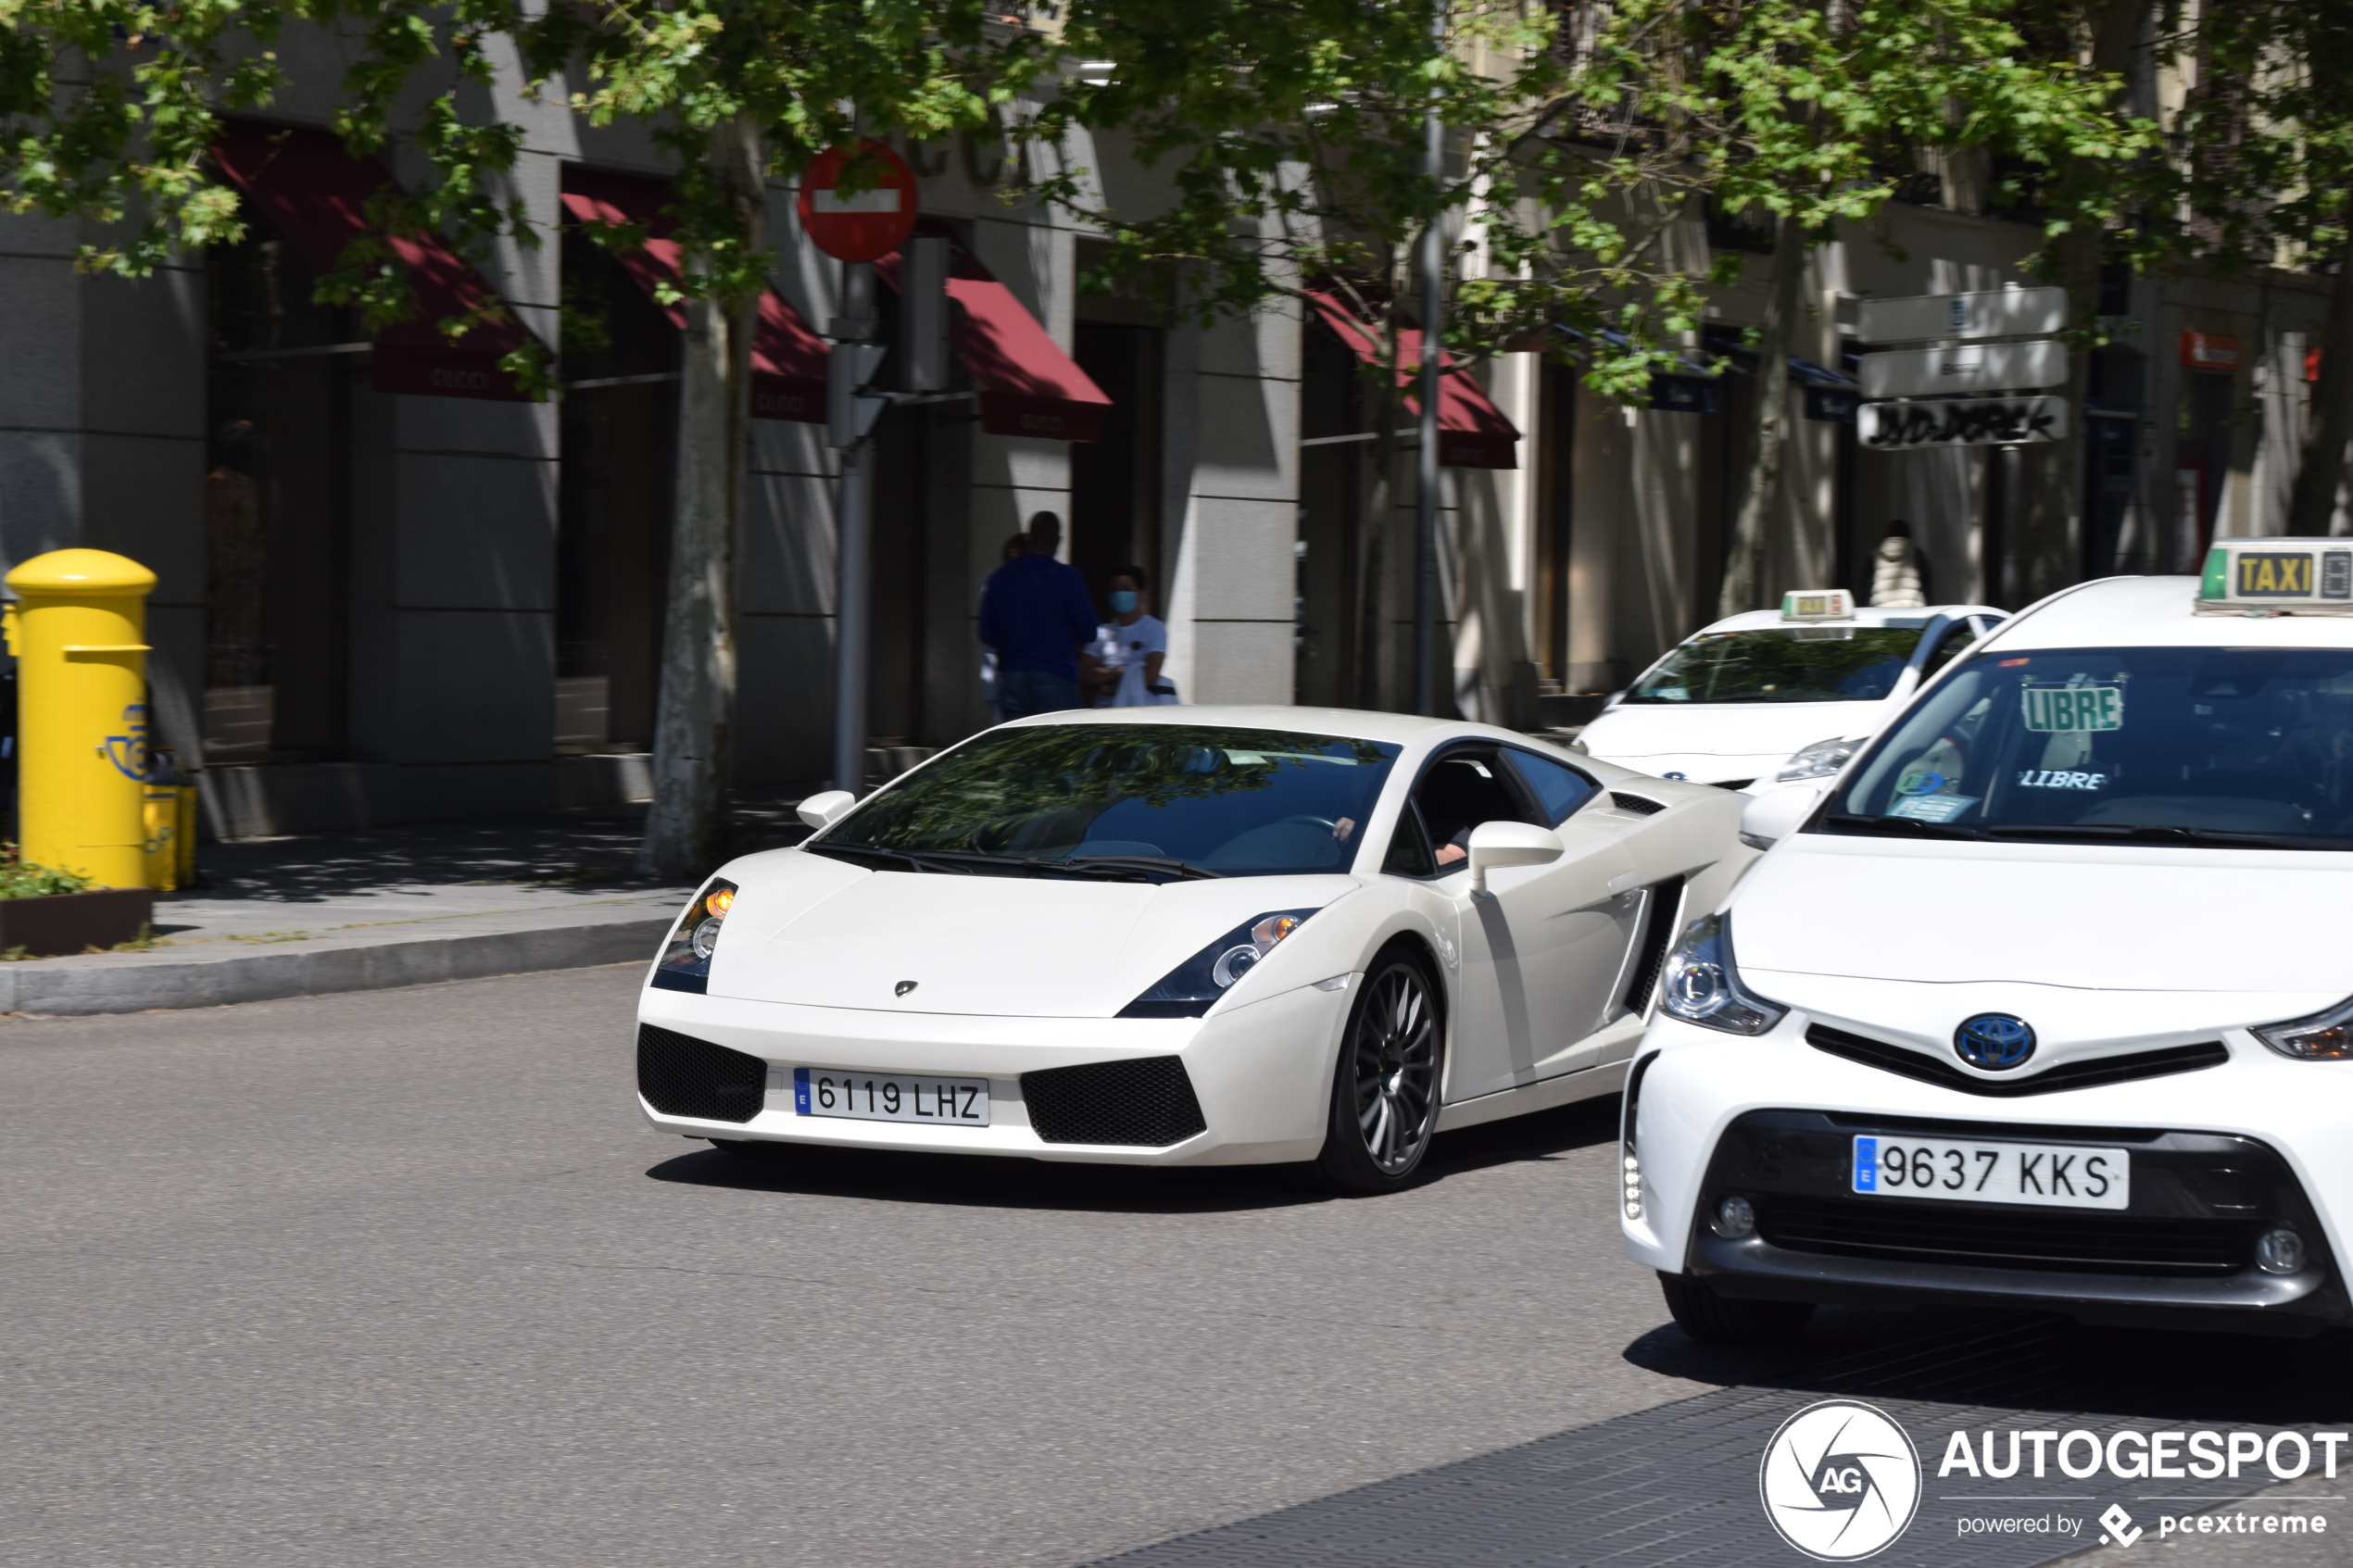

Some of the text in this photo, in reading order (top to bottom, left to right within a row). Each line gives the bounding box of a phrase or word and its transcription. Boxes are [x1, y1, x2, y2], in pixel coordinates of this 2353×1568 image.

[430, 368, 490, 389] GUCCI
[2239, 558, 2312, 592] TAXI
[1798, 597, 1825, 614] TAXI
[2027, 689, 2118, 730] LIBRE
[2020, 770, 2106, 790] LIBRE
[799, 1076, 980, 1119] E 6119 LHZ
[1861, 1146, 2108, 1198] E 9637 KKS
